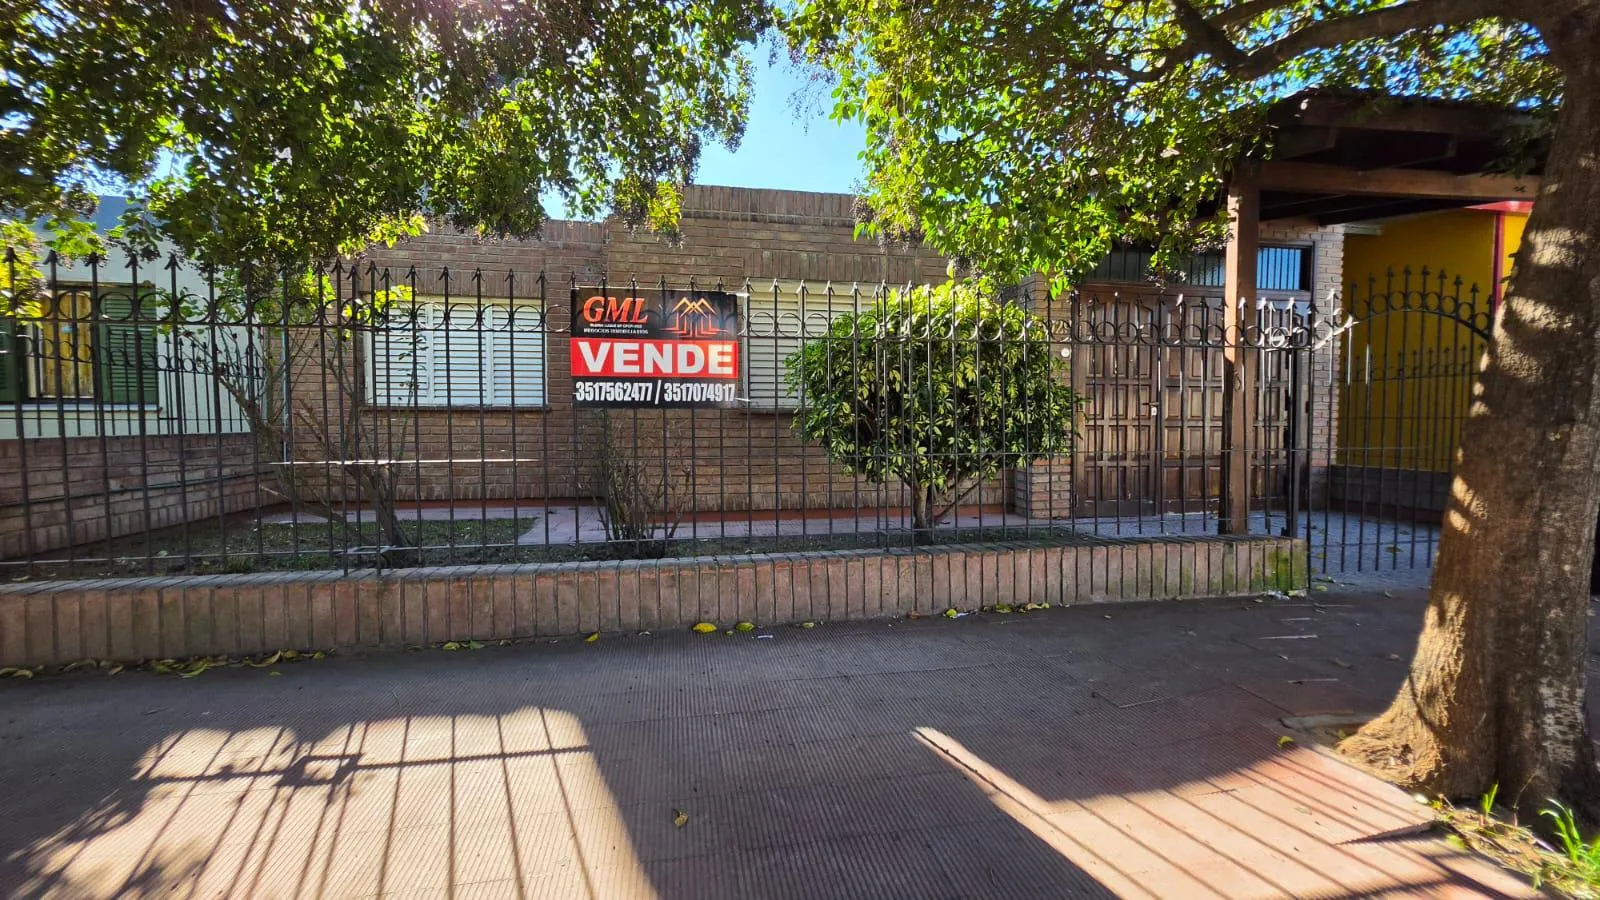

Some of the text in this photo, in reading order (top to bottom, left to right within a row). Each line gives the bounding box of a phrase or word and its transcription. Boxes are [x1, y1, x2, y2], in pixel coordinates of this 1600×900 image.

[583, 296, 648, 324] GML
[578, 341, 734, 375] VENDE
[576, 380, 736, 405] 3517562477 / 3517074917
